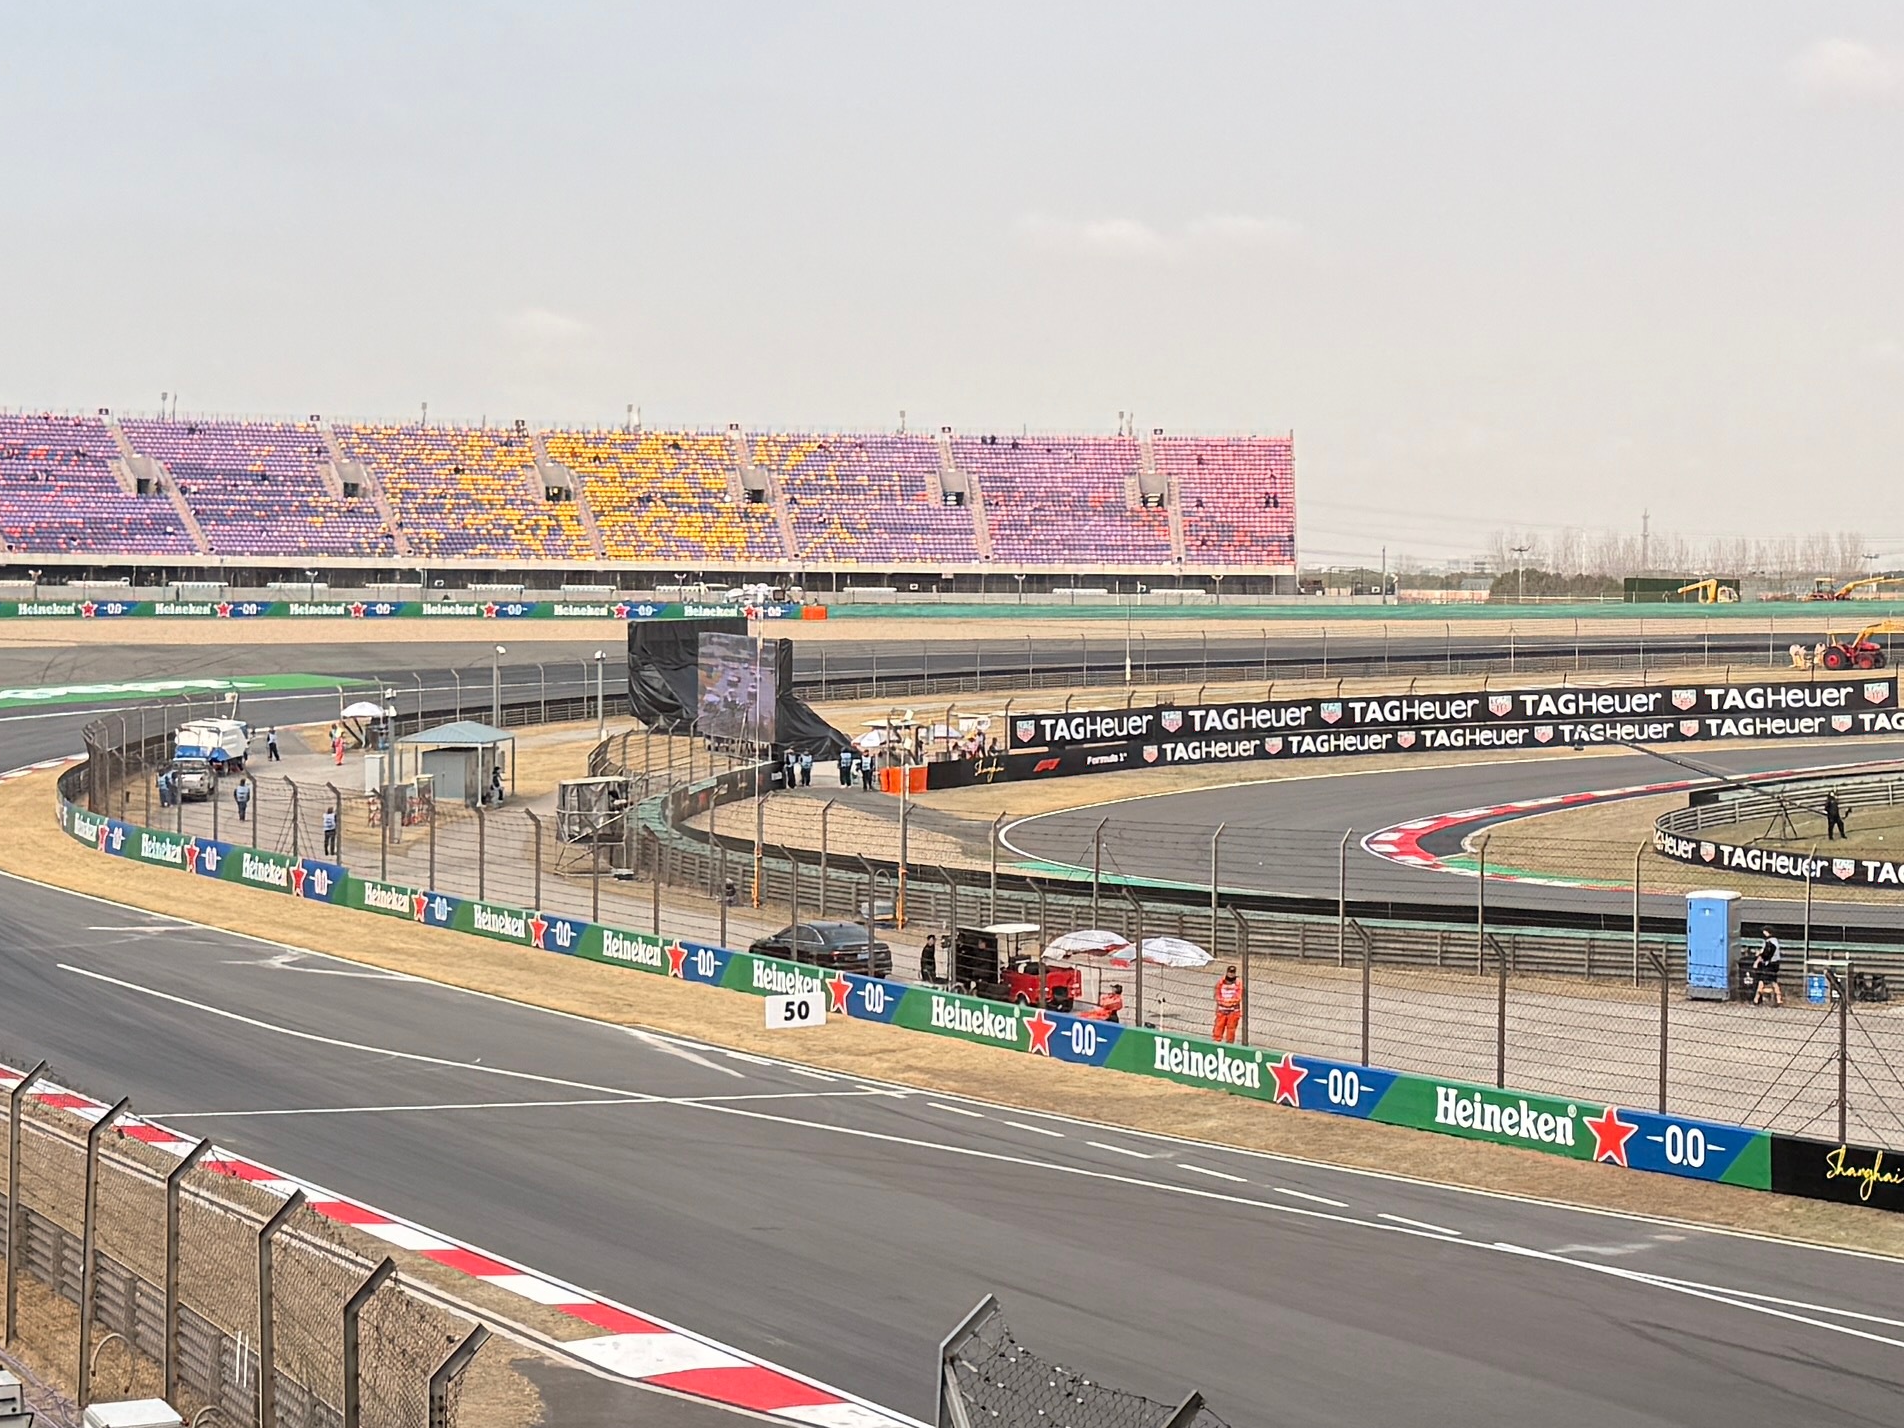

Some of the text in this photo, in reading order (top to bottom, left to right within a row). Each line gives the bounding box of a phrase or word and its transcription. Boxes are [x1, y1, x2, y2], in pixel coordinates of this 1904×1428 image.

[18, 604, 75, 615] Heineken
[155, 603, 211, 615] Heineken
[290, 603, 345, 615] Heineken
[423, 604, 477, 615] Heineken
[554, 605, 608, 616] Heineken
[684, 605, 738, 617] Heineken
[1520, 691, 1662, 716] TAGHeuer
[1705, 685, 1853, 710] TAGHeuer
[1188, 706, 1312, 732] TAGHeuer
[1349, 698, 1479, 723] TAGHeuer
[1040, 715, 1153, 743] TAGHeuer
[1421, 728, 1529, 748] TAGHeuer
[1706, 716, 1825, 736] TAGHeuer
[1162, 739, 1260, 761] TAGHeuer
[1288, 733, 1392, 754] TAGHeuer
[141, 833, 184, 863] Heineken
[242, 852, 289, 886] Heineken
[364, 882, 410, 912] Heineken
[473, 904, 526, 938] Heineken
[602, 930, 715, 977] Heineken 0.0
[753, 960, 884, 1014] Heineken 0.0
[784, 1000, 809, 1021] 50
[931, 995, 1095, 1057] Heineken 0.0
[1154, 1036, 1359, 1107] Heineken 0.0
[1436, 1086, 1705, 1167] Heineken 0.0
